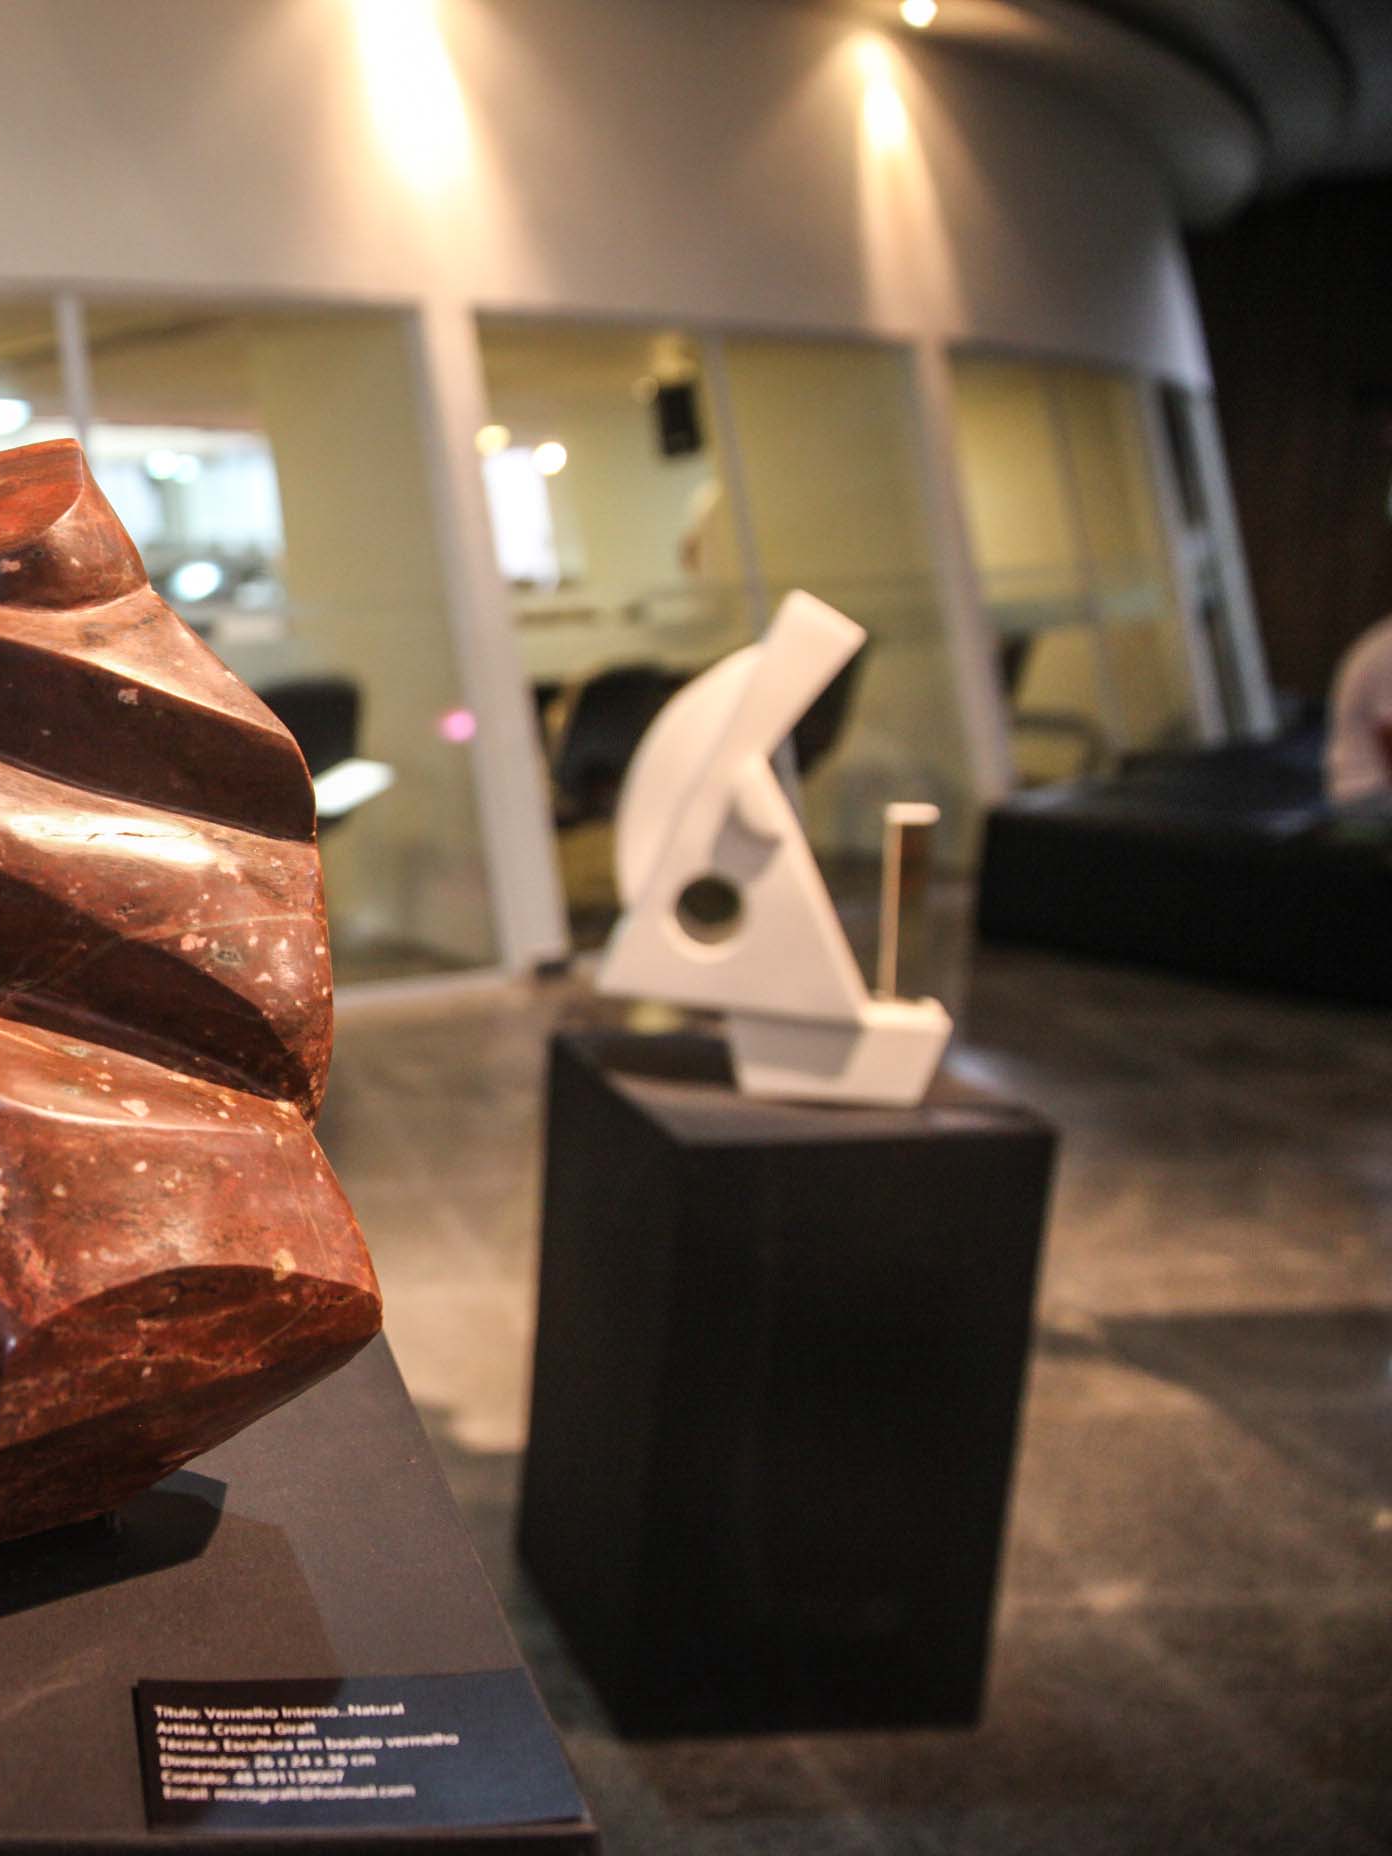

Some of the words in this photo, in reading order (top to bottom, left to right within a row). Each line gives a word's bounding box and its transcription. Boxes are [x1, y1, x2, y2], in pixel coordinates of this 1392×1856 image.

[204, 1705, 279, 1720] Vermelho
[212, 1722, 272, 1737] Cristina
[274, 1721, 317, 1736] Giralt
[296, 1739, 323, 1752] em
[385, 1733, 460, 1749] vermelho
[350, 1753, 377, 1768] cm
